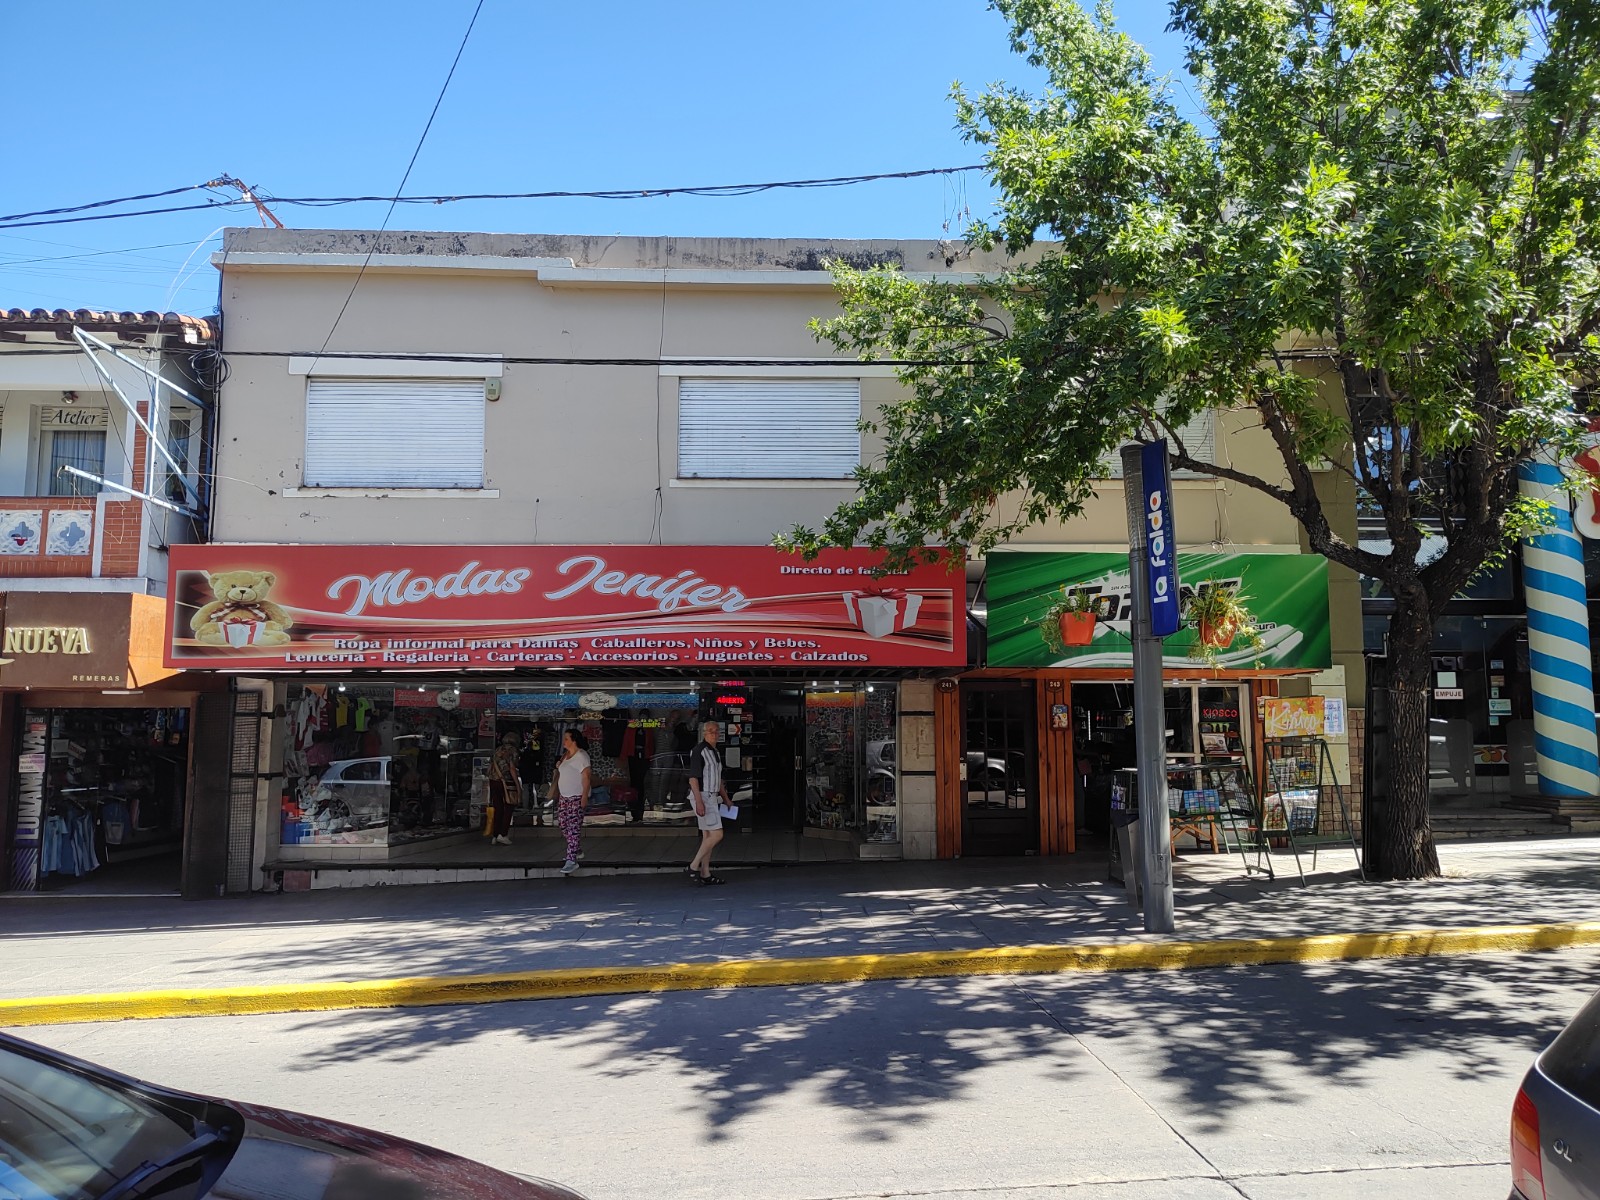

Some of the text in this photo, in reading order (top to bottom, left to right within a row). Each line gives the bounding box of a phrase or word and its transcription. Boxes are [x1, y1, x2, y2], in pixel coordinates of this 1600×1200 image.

[51, 409, 100, 425] Atelier
[1148, 490, 1168, 603] la falda
[780, 565, 832, 574] Directo
[836, 566, 853, 575] de
[327, 555, 752, 616] Modas Jenifer
[3, 627, 91, 654] NUEVA
[334, 638, 381, 650] Ropa
[391, 638, 465, 649] informal
[470, 640, 511, 651] para
[591, 637, 691, 649] Caballeros,
[693, 637, 743, 648] Niños
[748, 640, 758, 649] y
[764, 638, 821, 648] Bebes.
[285, 651, 869, 663] Lenceria Regaleria Carteras Accesorios Juguetes Calzados
[1435, 689, 1462, 697] EMPUJE
[1203, 708, 1238, 718] KIOSCO
